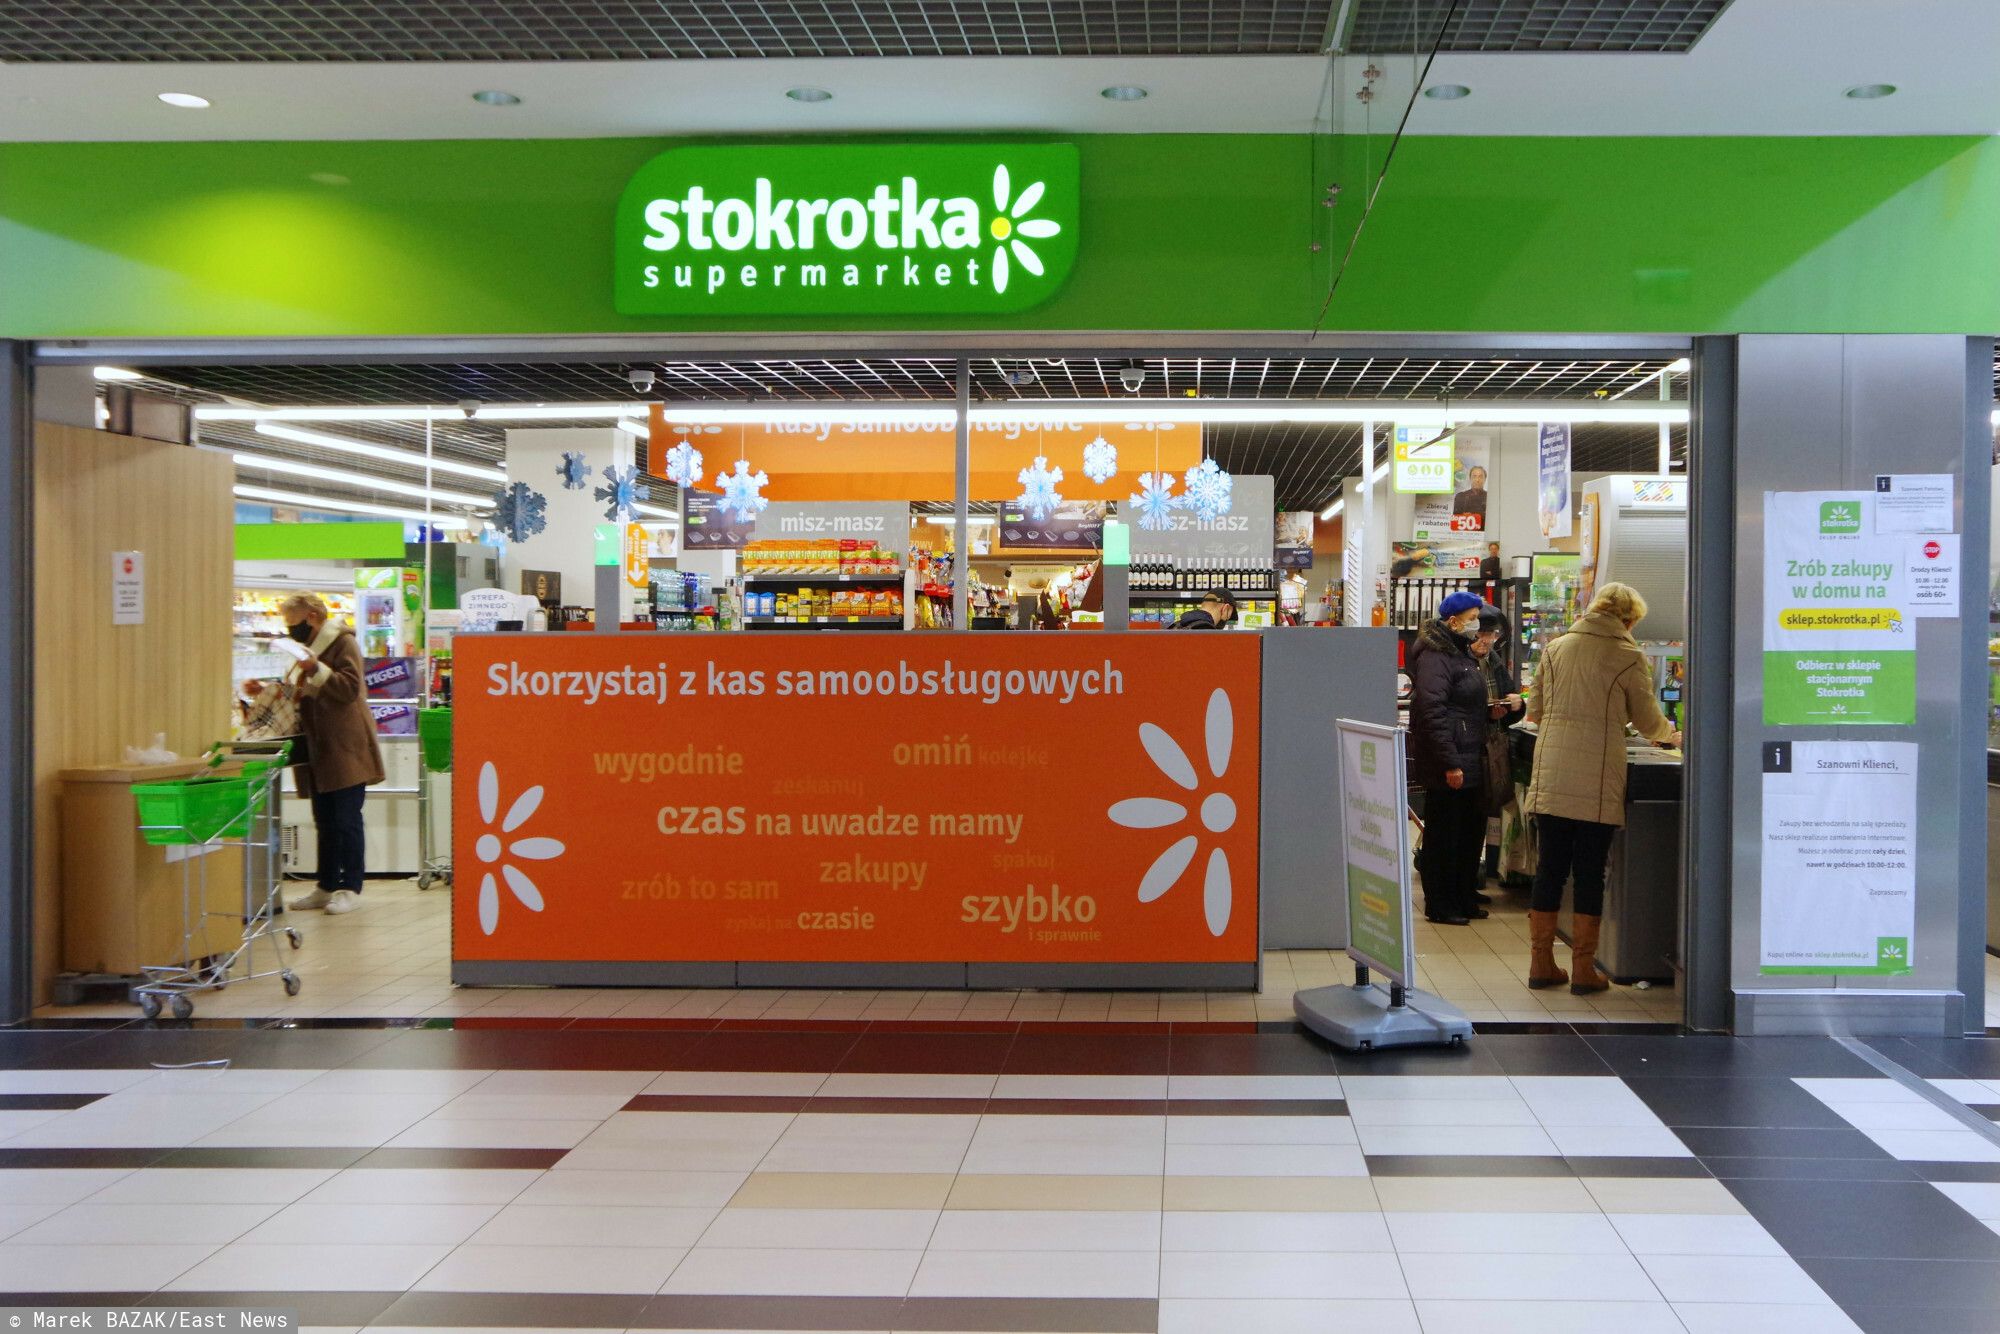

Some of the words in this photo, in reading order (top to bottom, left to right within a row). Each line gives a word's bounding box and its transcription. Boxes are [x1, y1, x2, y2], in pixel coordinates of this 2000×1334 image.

[643, 177, 980, 250] stokrotka
[643, 256, 979, 294] supermarket
[781, 512, 884, 532] misz-masz
[1822, 519, 1858, 527] stokrotka
[1786, 559, 1826, 577] Zrób
[1832, 560, 1893, 581] zakupy
[1792, 586, 1807, 598] w
[1812, 581, 1863, 598] domu
[1866, 585, 1886, 598] na
[1786, 614, 1880, 627] sklep.stokrotka.pl
[365, 664, 406, 686] TIGER
[1796, 660, 1834, 670] Odbierz
[1835, 662, 1845, 670] w
[1847, 660, 1881, 672] sklepie
[487, 663, 668, 704] Skorzystaj
[679, 671, 697, 695] z
[707, 661, 765, 696] kas
[776, 659, 1124, 704] samoobsługowych
[1807, 674, 1873, 685] stacjonarnym
[1817, 687, 1865, 697] Stokrotka
[893, 734, 971, 765] omiń
[594, 743, 743, 782] wygodnie
[1817, 759, 1861, 769] Szanowni
[1863, 759, 1899, 771] Klienci,
[656, 805, 746, 835] czas
[755, 813, 791, 836] na
[802, 806, 919, 836] uwadze
[929, 812, 1024, 843] mamy
[820, 854, 928, 890] zakupy
[993, 851, 1055, 871] spakuj
[622, 873, 681, 900] zrób
[688, 877, 716, 900] to
[724, 880, 779, 900] sam
[797, 906, 875, 930] czasie
[961, 884, 1097, 932] szybko
[1028, 927, 1034, 942] i
[1035, 927, 1101, 945] sprawnie
